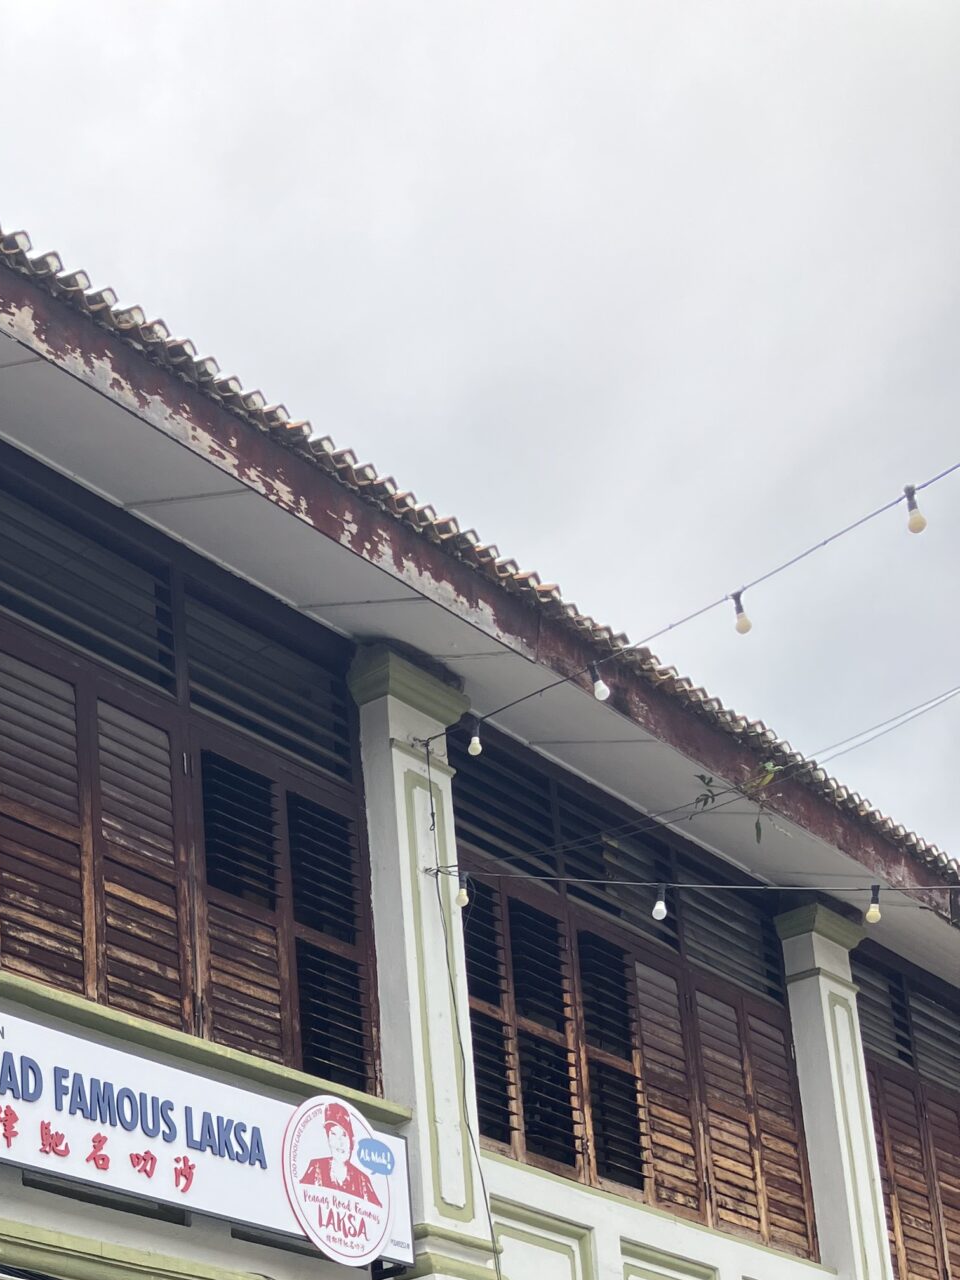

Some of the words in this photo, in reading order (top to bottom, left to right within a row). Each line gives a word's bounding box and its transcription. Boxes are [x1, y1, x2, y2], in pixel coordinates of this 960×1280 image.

[54, 1066, 178, 1143] FAMOUS
[184, 1106, 267, 1170] LAKSA
[303, 1189, 330, 1209] Penang
[332, 1196, 351, 1213] Road
[355, 1202, 380, 1225] Famous
[318, 1204, 369, 1241] LAKSA
